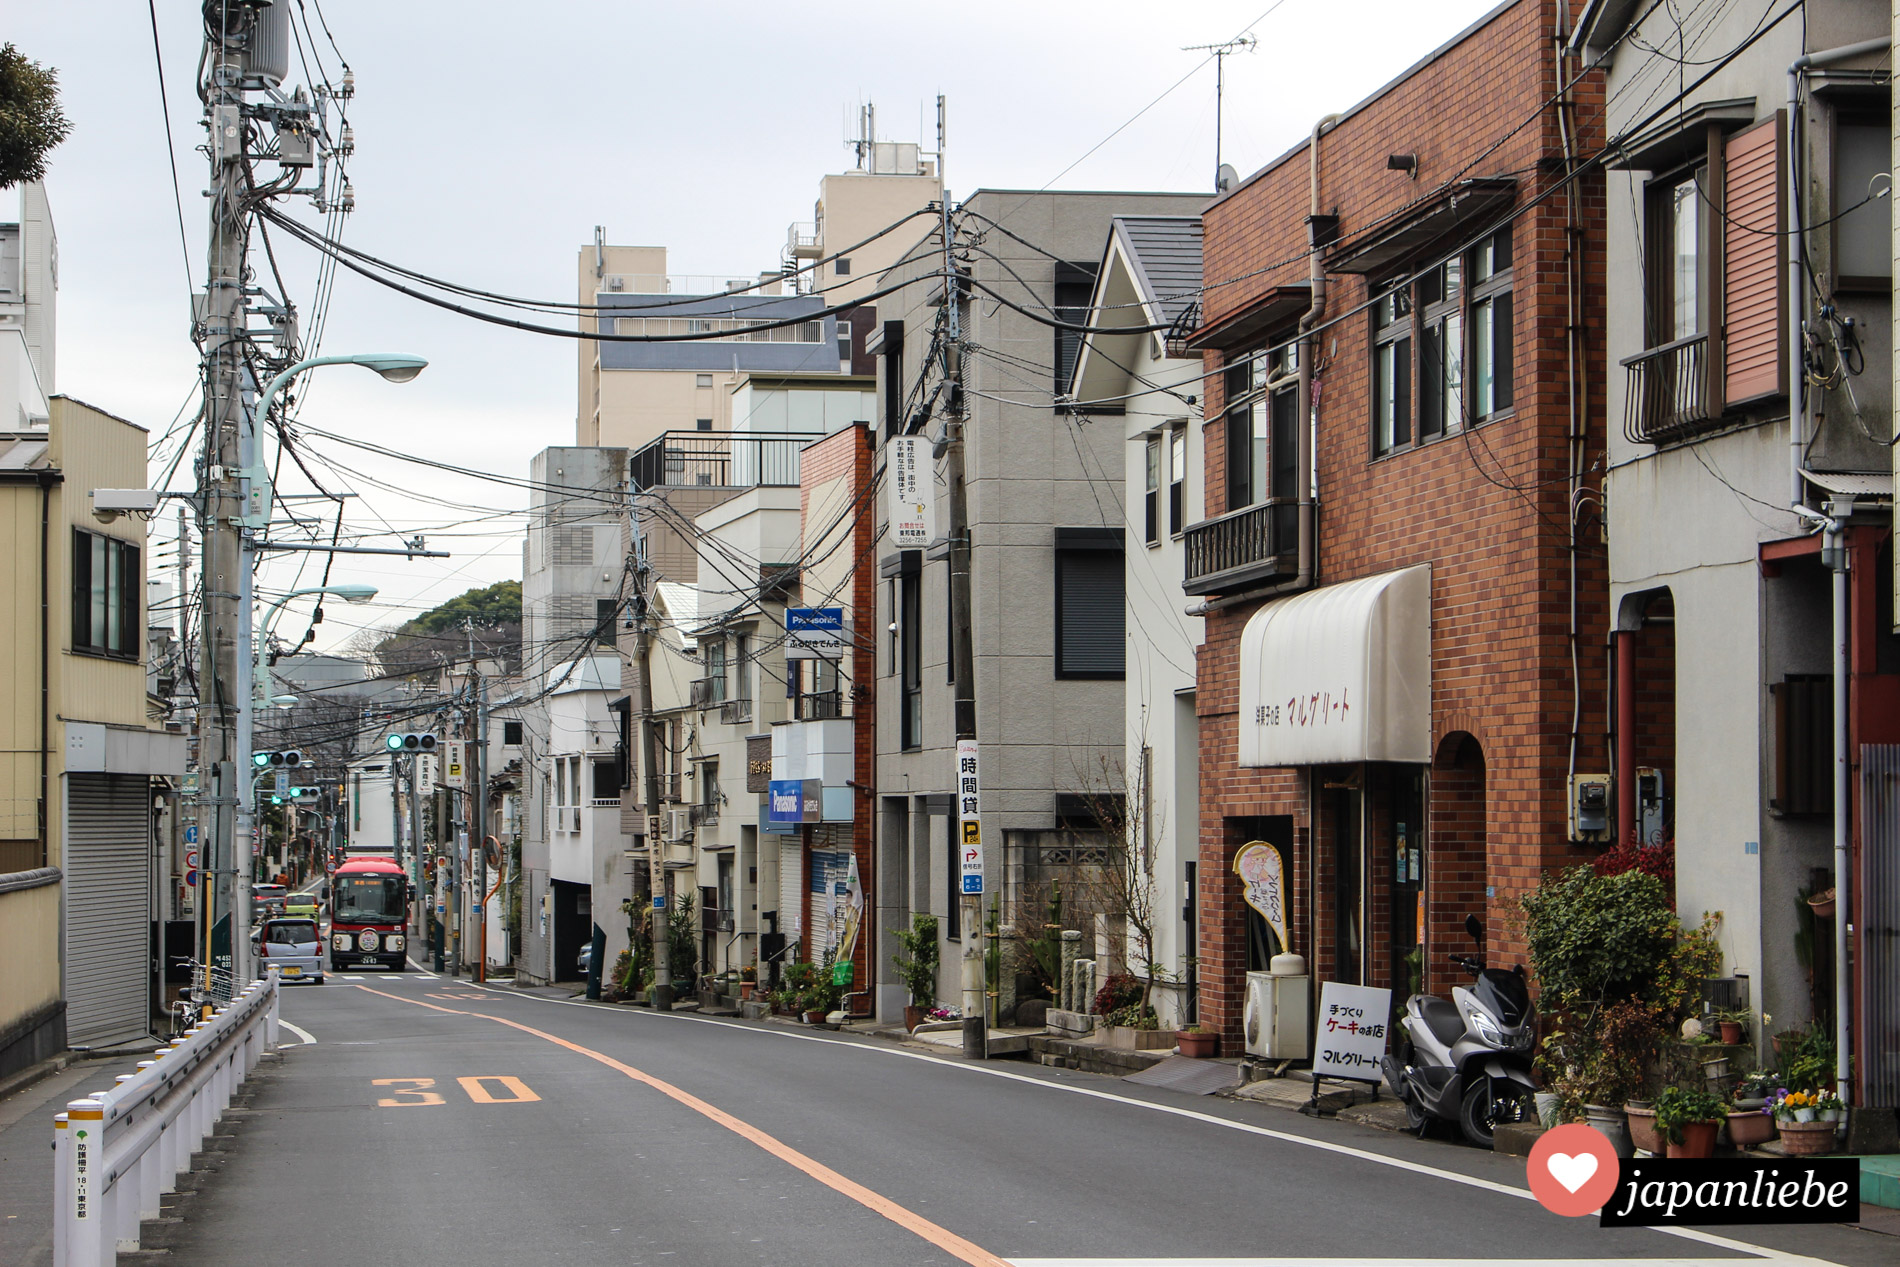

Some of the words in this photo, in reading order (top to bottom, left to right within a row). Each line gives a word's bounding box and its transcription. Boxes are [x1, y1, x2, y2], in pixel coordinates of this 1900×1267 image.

[792, 615, 837, 624] Paasonic
[1255, 705, 1280, 726] 洋菓子の店
[450, 764, 460, 775] P
[961, 757, 978, 814] 時間貸
[773, 789, 798, 813] Panasonic
[963, 821, 979, 843] P
[1329, 1004, 1363, 1018] 手づくり
[1326, 1017, 1385, 1038] ケーキのお店
[1323, 1050, 1380, 1068] マルグリート
[371, 1075, 543, 1107] 30
